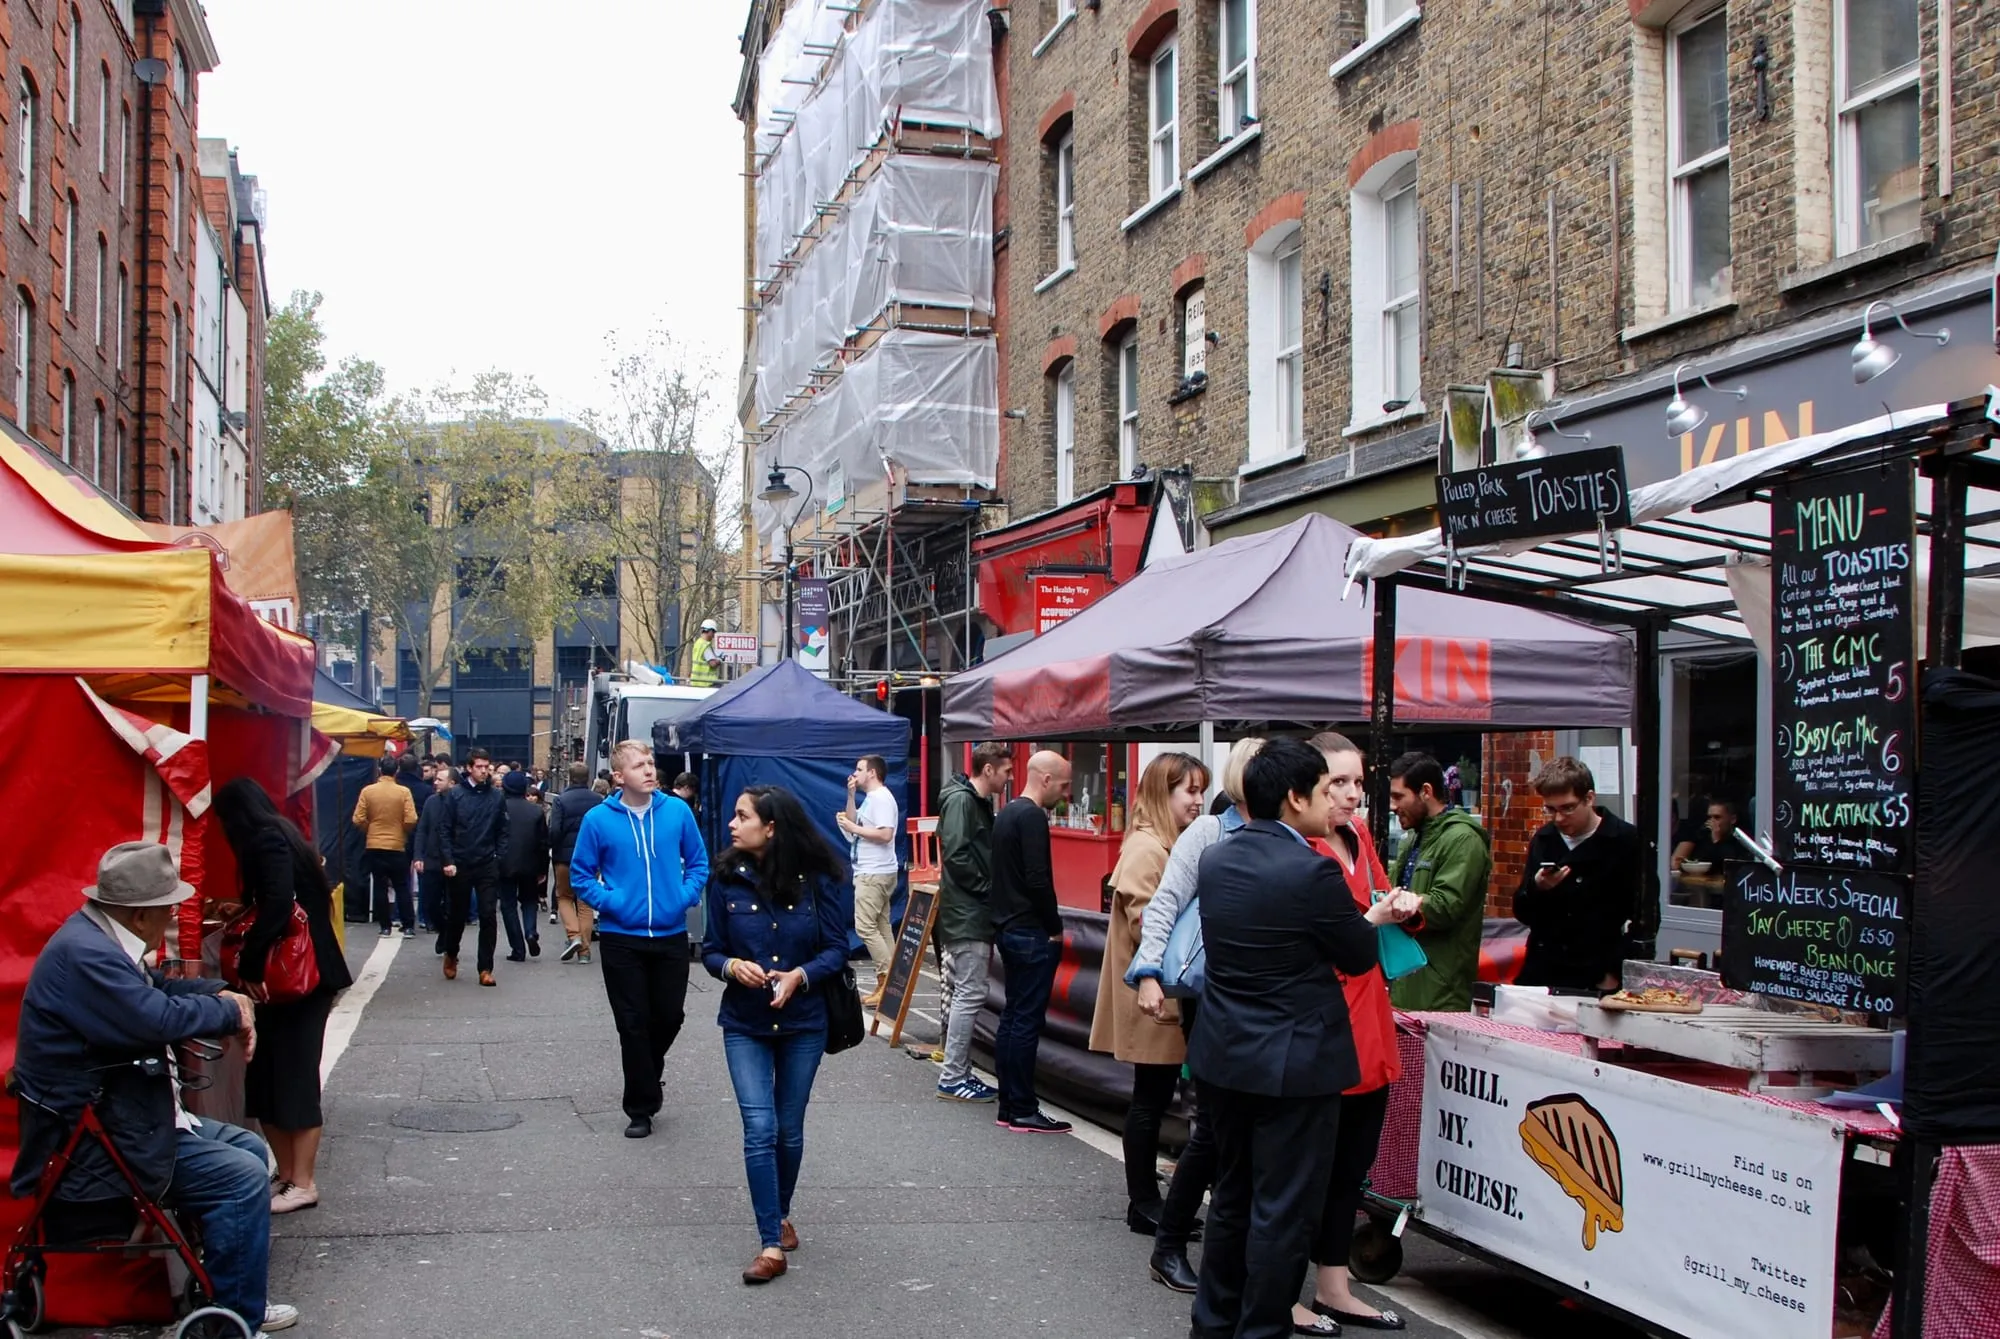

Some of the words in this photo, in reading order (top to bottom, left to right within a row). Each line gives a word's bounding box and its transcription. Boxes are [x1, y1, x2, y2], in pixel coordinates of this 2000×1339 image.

[1442, 477, 1475, 503] PULLED
[1478, 472, 1508, 497] PORK
[1516, 468, 1621, 521] TOASTIES
[1448, 514, 1468, 535] MAC
[1485, 506, 1518, 526] CHEESE
[1797, 493, 1864, 552] MENU
[1781, 563, 1798, 587] All
[1801, 567, 1818, 583] our
[1822, 543, 1909, 581] TOASTIES
[1040, 585, 1052, 593] The
[1076, 586, 1090, 596] Way
[1062, 596, 1074, 604] Spa
[718, 637, 755, 649] SPRING
[1833, 632, 1882, 667] GMC
[1884, 660, 1904, 700] 5
[1881, 733, 1900, 772] 6
[1801, 803, 1832, 829] MAC
[1833, 801, 1882, 828] ATTACK
[1737, 871, 1774, 904] THIS
[1839, 878, 1904, 920] SPECIAL
[1747, 907, 1774, 936] JAY
[1774, 910, 1837, 941] CHEESE
[1754, 956, 1799, 973] HOMEMADE
[1800, 964, 1830, 981] BAKED
[1792, 974, 1821, 989] CHEESE
[1820, 980, 1848, 993] BLEND
[1750, 980, 1767, 993] ADD
[1767, 983, 1804, 998] GRILLED
[1804, 989, 1849, 1007] SAUSAGE
[1440, 1059, 1509, 1108] GRILL.
[1438, 1108, 1473, 1149] MY.
[1435, 1159, 1524, 1221] CHEESE.
[1642, 1152, 1812, 1216] www.grillmycheese.co.uk
[1733, 1154, 1765, 1177] Find
[1771, 1167, 1788, 1183] us
[1796, 1177, 1813, 1191] on
[1684, 1254, 1806, 1314] @grill_my_cheese
[1751, 1256, 1808, 1289] Twitter
